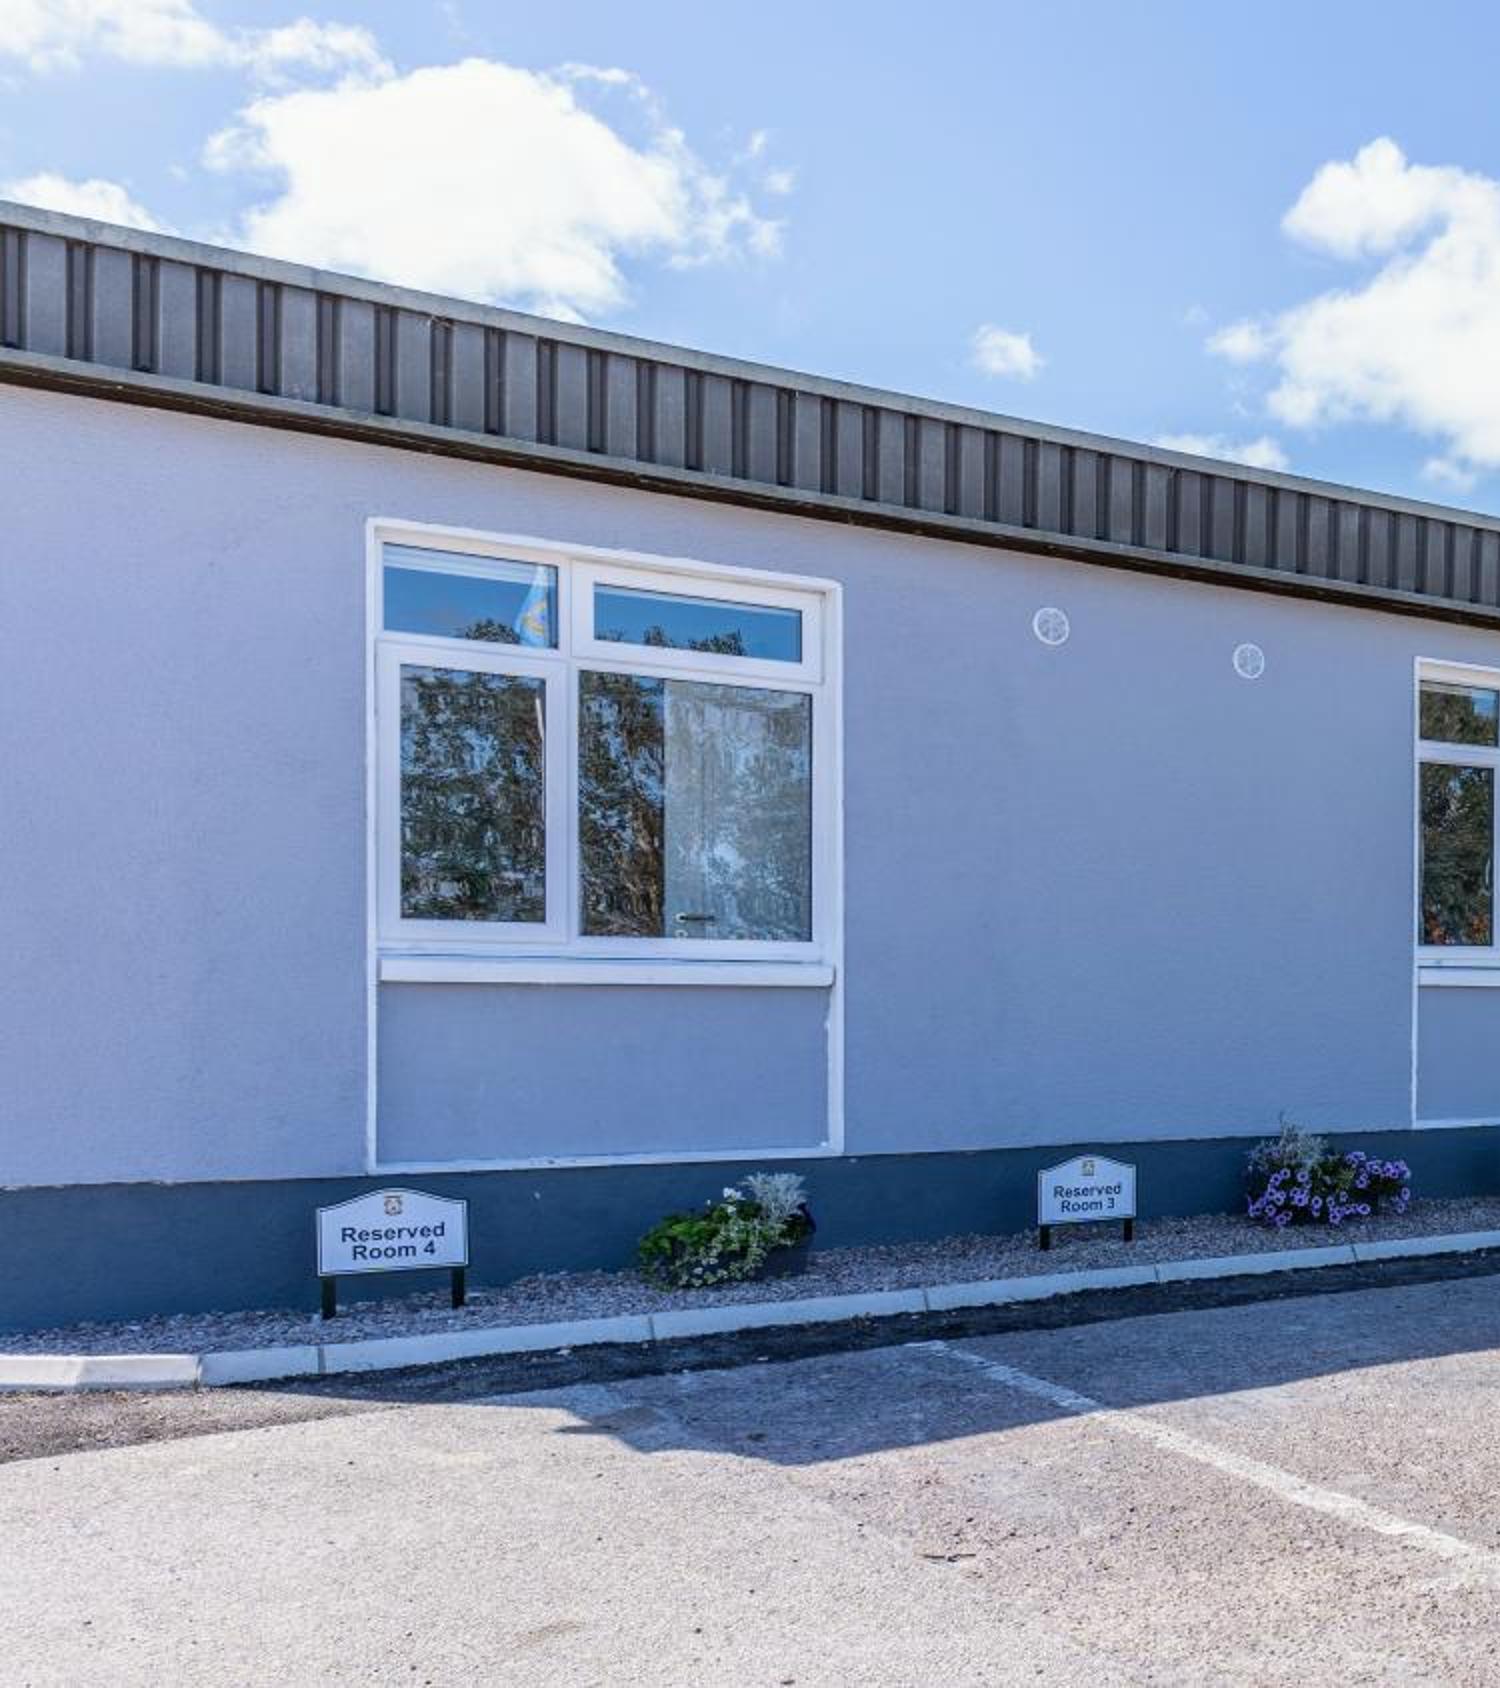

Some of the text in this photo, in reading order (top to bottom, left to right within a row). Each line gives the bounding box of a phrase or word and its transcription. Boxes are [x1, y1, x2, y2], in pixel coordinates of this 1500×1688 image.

[1053, 1181, 1122, 1199] Reserved
[1061, 1197, 1115, 1213] Room 3
[341, 1221, 445, 1243] Reserved
[352, 1240, 436, 1260] Room 4
